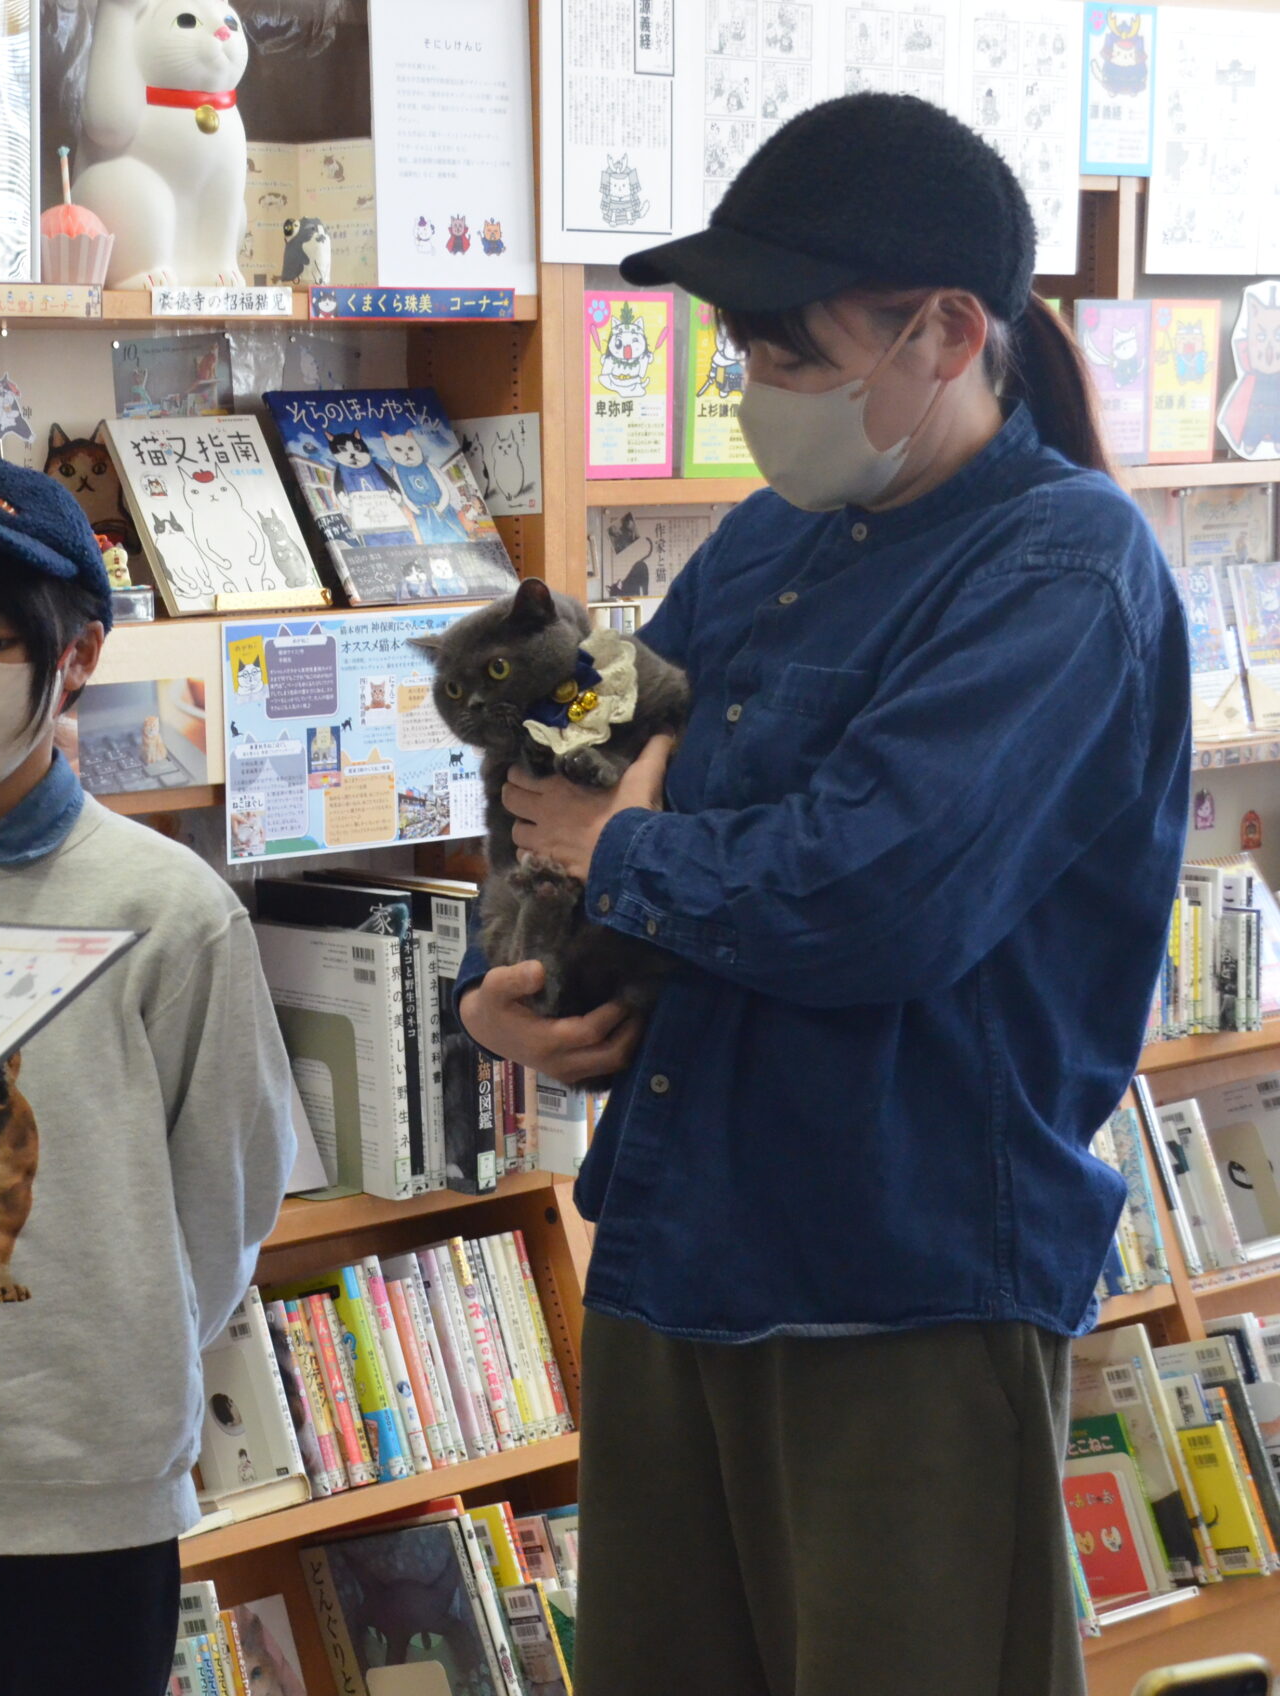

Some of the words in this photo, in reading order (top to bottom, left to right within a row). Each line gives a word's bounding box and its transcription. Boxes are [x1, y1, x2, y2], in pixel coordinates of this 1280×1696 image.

[424, 37, 483, 53] そにしけんじ
[40, 300, 81, 313] コーナー
[346, 288, 433, 314] くまくら珠美
[450, 294, 504, 313] コーナー
[286, 397, 441, 433] そらのほんやさん
[595, 400, 634, 418] 卑弥呼
[130, 430, 261, 467] 猫又指南
[655, 523, 667, 583] 作家と猫
[369, 902, 395, 935] 家
[426, 941, 443, 1085] 野生ネコの教科書
